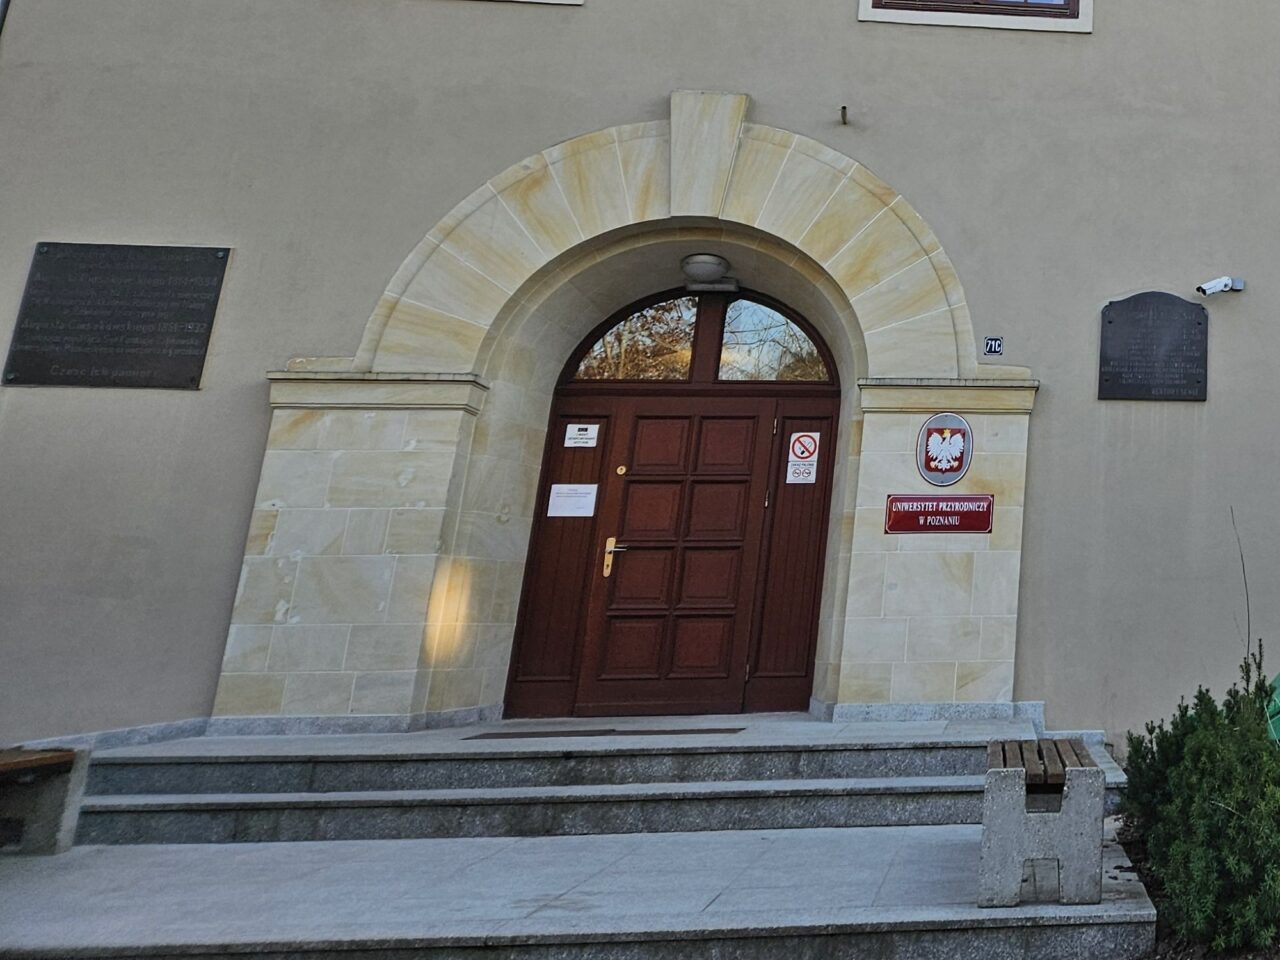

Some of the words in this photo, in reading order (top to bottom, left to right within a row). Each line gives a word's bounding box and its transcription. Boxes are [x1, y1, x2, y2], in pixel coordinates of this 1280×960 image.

[986, 340, 1001, 352] 71C
[892, 502, 937, 511] UNIWERSYTET
[938, 501, 988, 511] PRZYRODNICZY
[919, 516, 925, 525] W
[927, 516, 960, 525] POZNANIU
